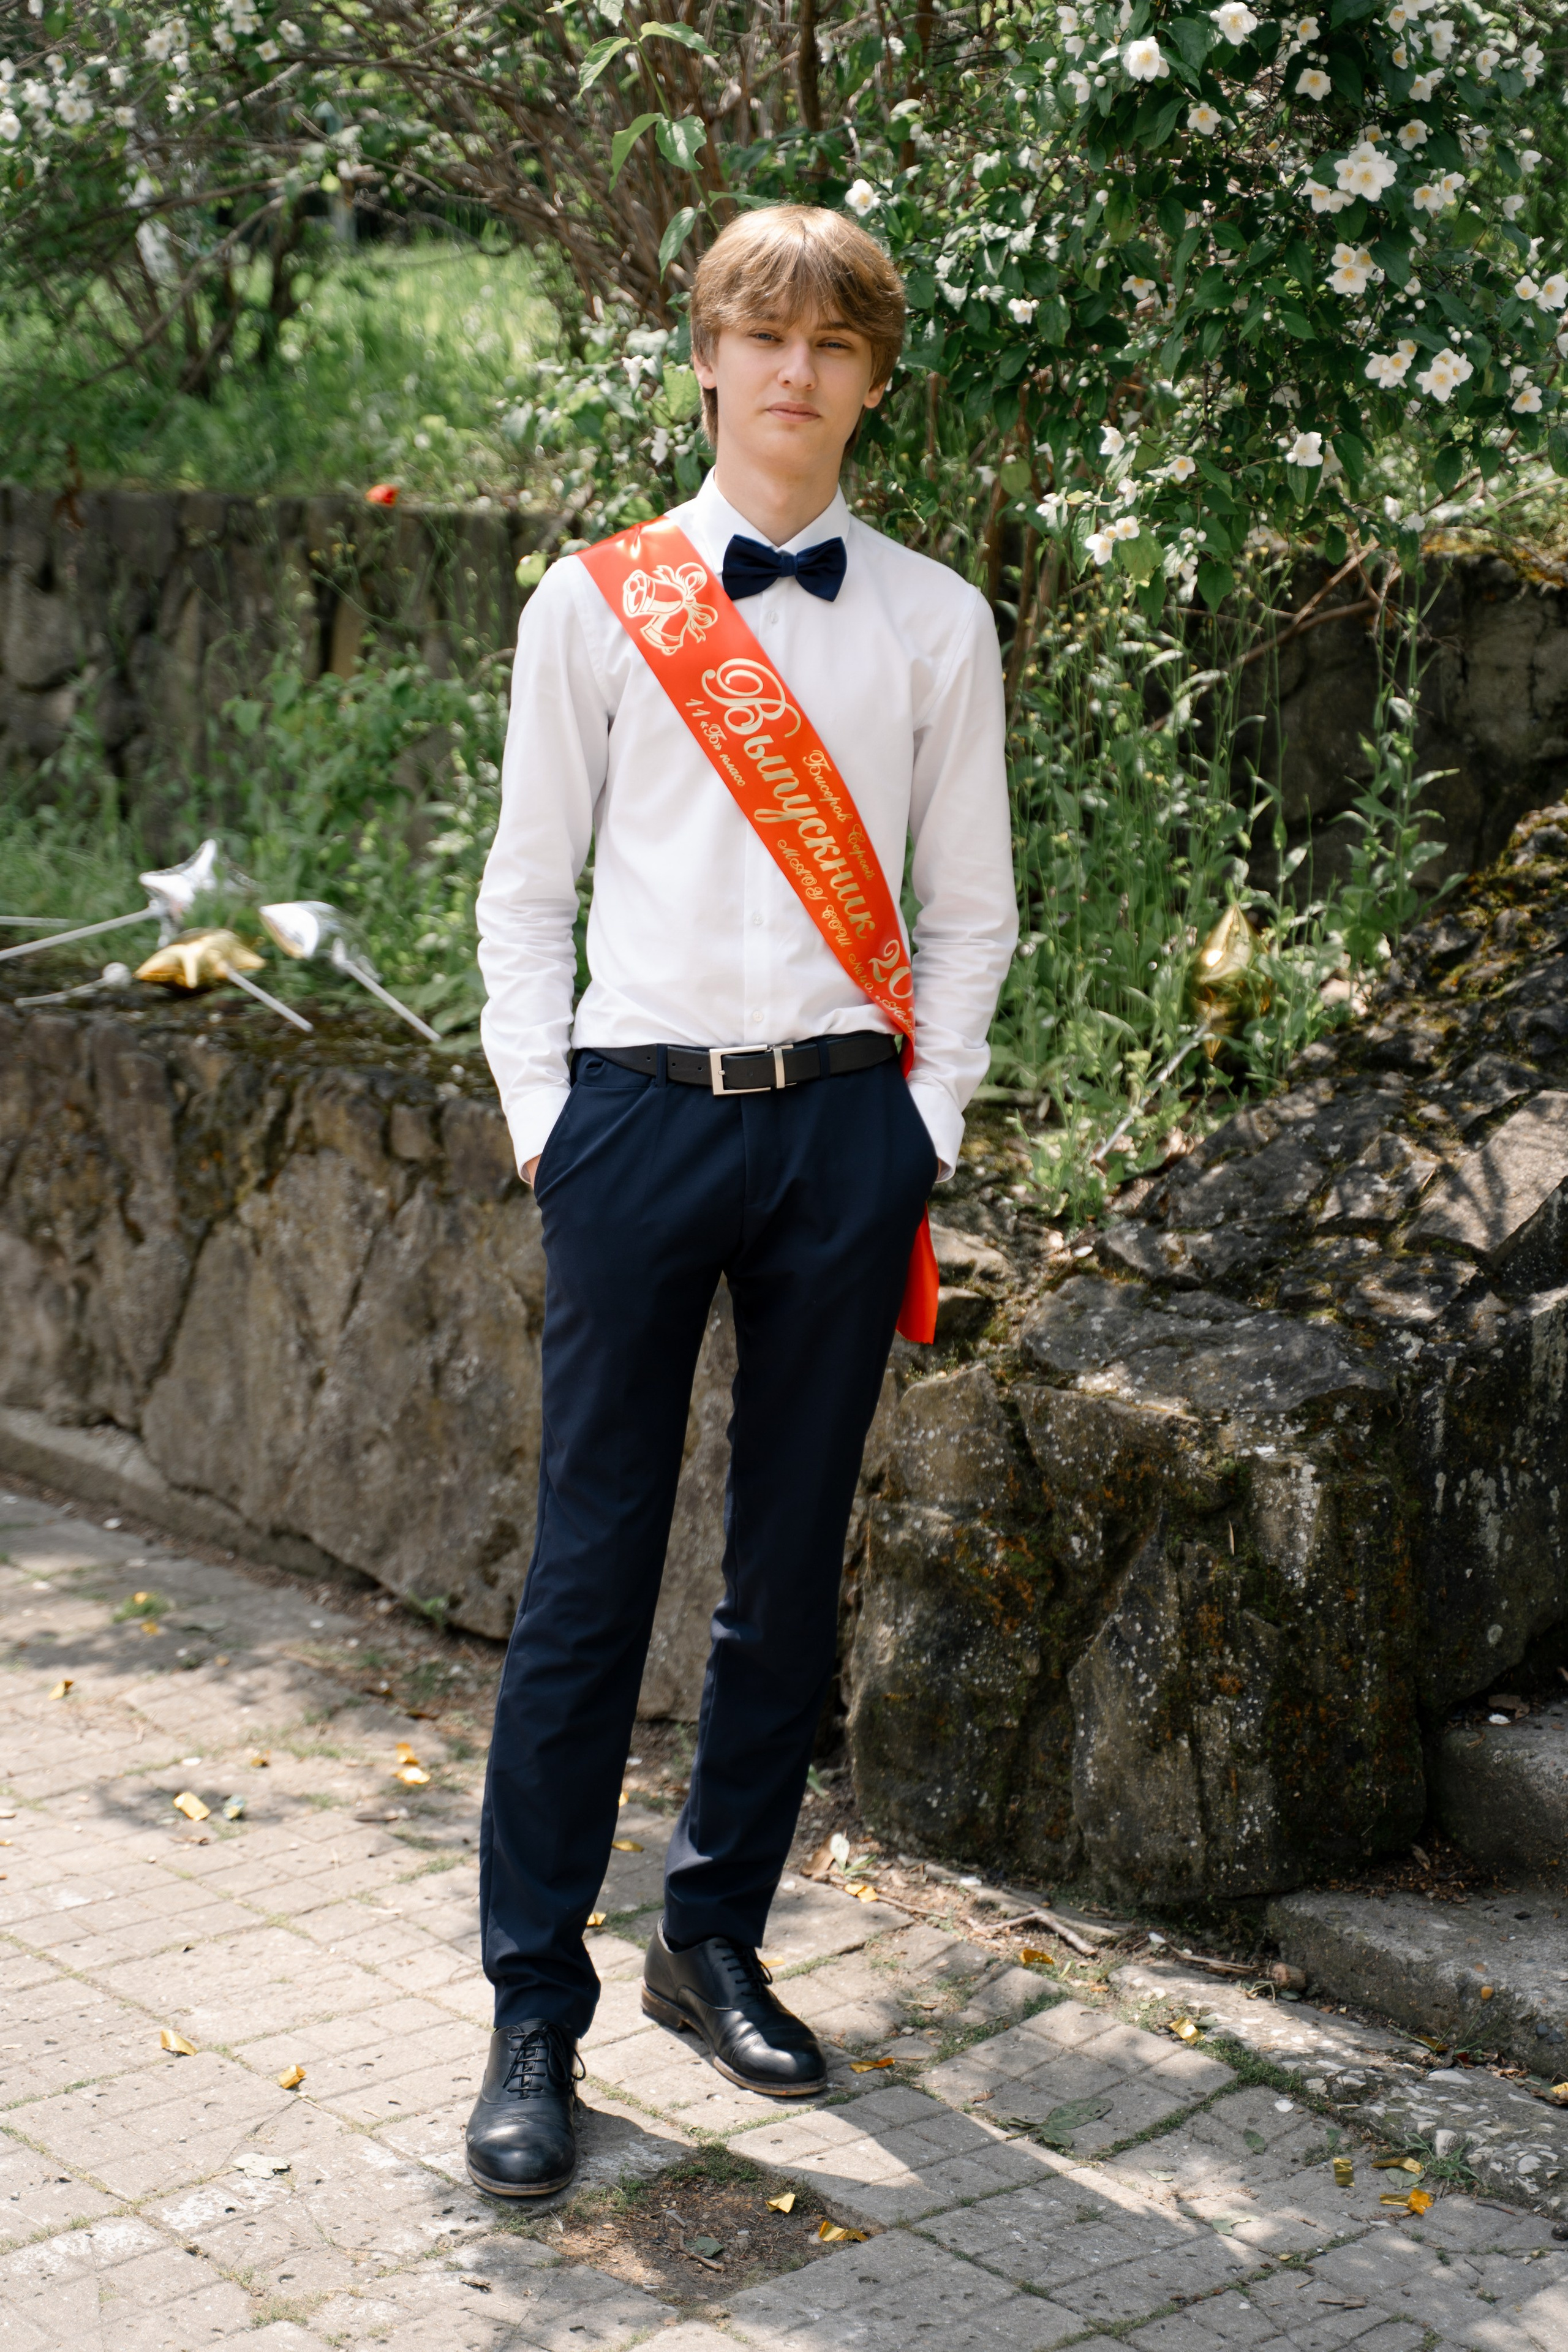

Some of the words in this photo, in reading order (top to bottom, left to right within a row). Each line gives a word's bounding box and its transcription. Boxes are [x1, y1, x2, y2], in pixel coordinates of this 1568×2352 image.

[685, 698, 711, 717] 11
[719, 753, 746, 787] класс
[701, 658, 876, 940] Выпускник
[868, 939, 914, 1012] 20
[802, 749, 854, 823] Бисеров
[847, 823, 875, 880] Сергей
[777, 839, 829, 900] МАОУ
[821, 904, 853, 948] СОШ
